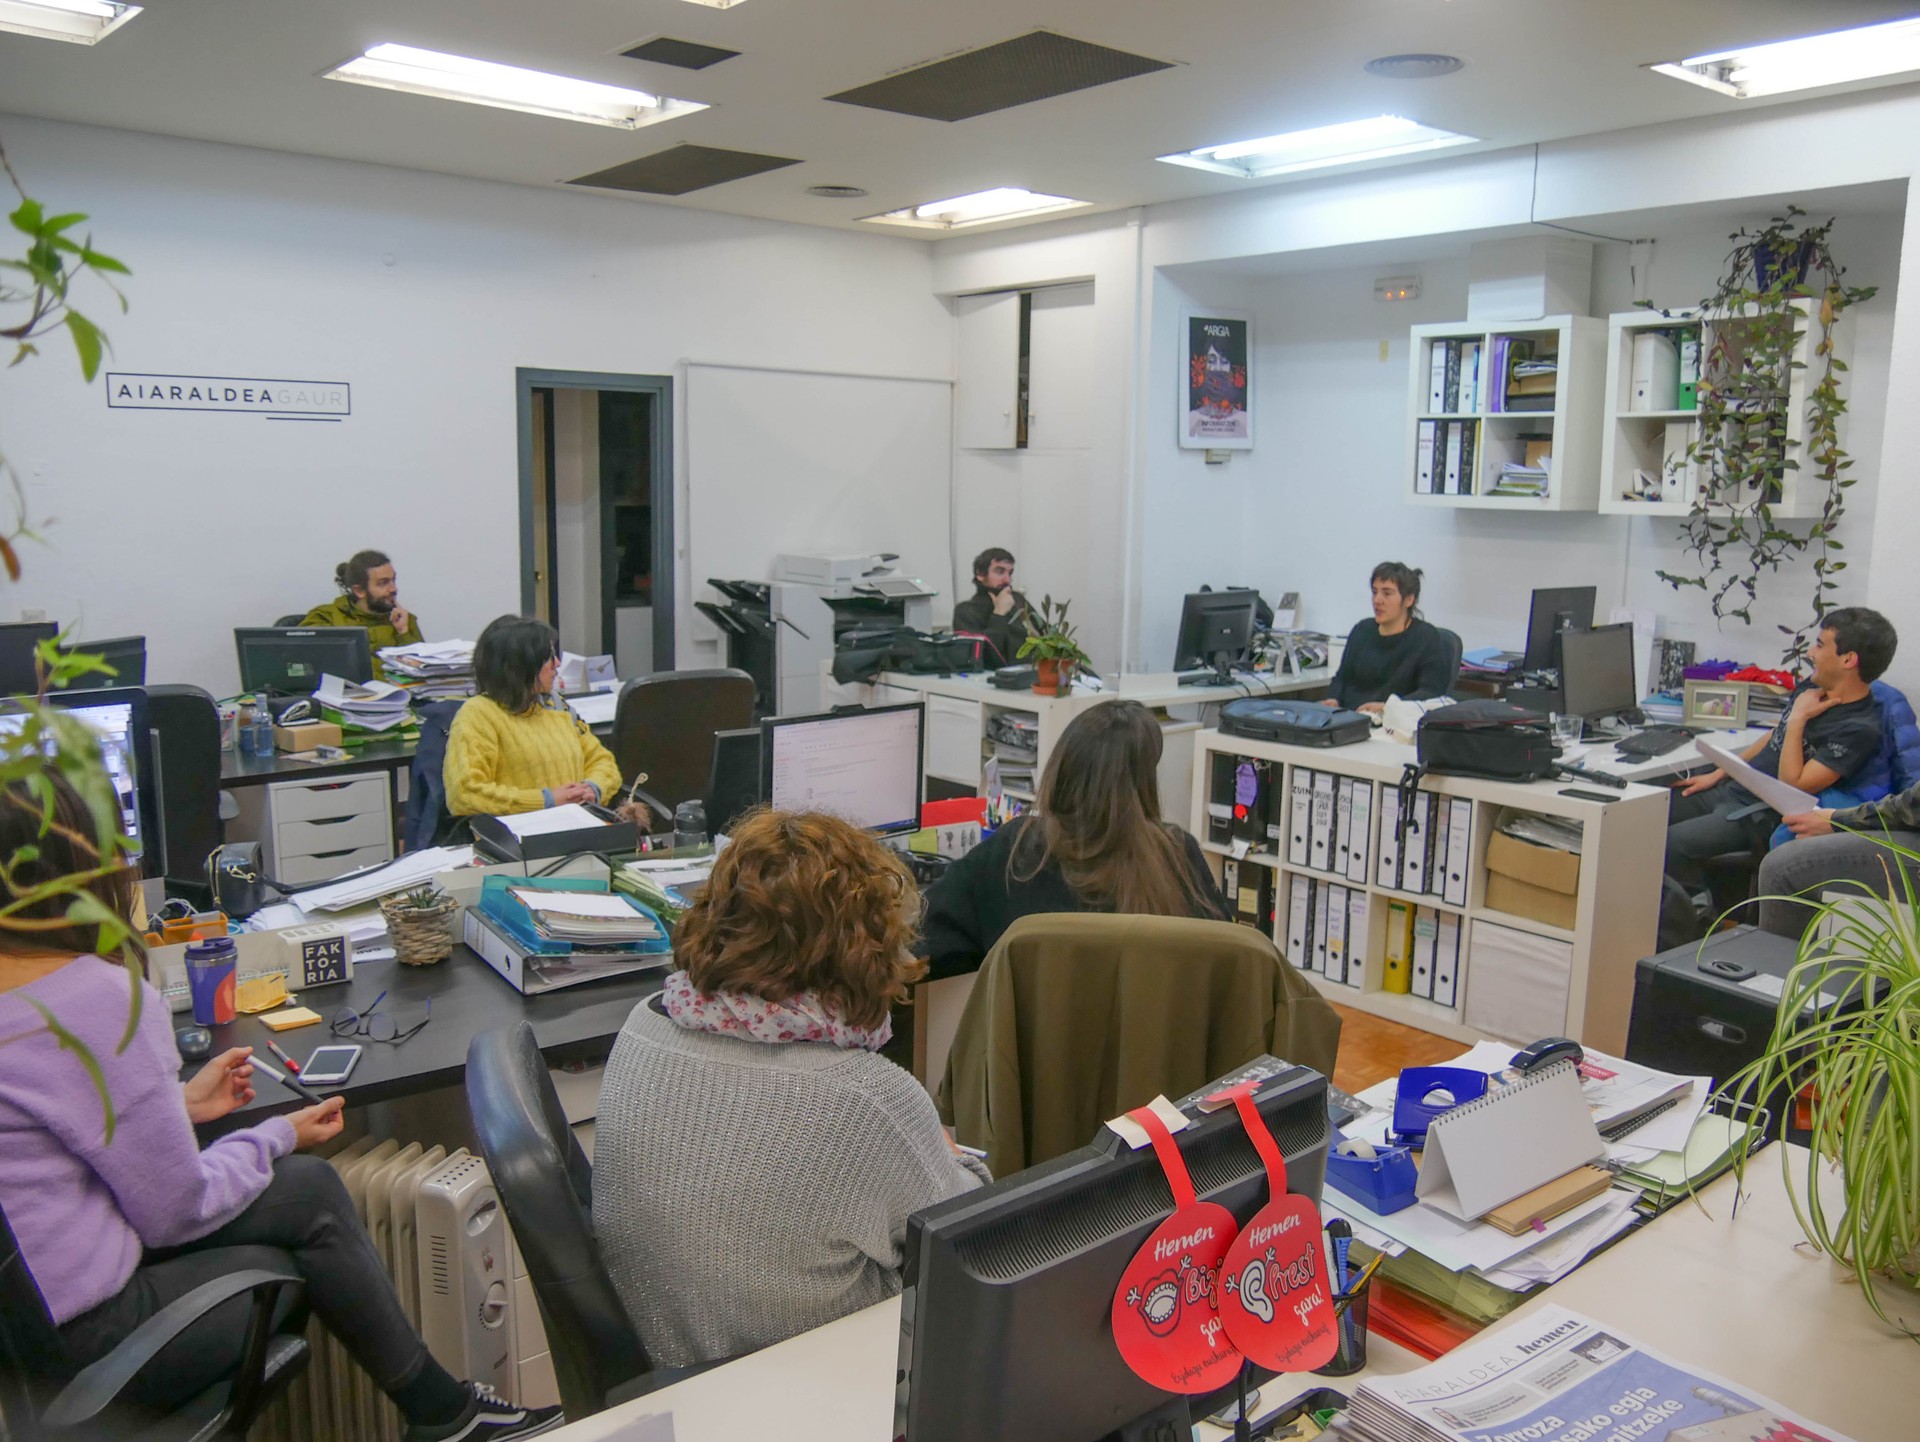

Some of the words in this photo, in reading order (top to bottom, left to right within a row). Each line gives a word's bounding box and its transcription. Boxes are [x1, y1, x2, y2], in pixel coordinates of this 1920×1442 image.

[305, 942, 341, 958] FAK
[305, 957, 338, 971] TO-
[306, 968, 338, 984] RIA
[1153, 1226, 1215, 1262] Hemen
[1249, 1213, 1301, 1249] Hemen
[1268, 1241, 1316, 1301] Prest
[1293, 1283, 1325, 1327] gara!
[1393, 1355, 1519, 1401] AIARALDEA
[1515, 1319, 1581, 1356] hemen
[1608, 1387, 1658, 1416] egia
